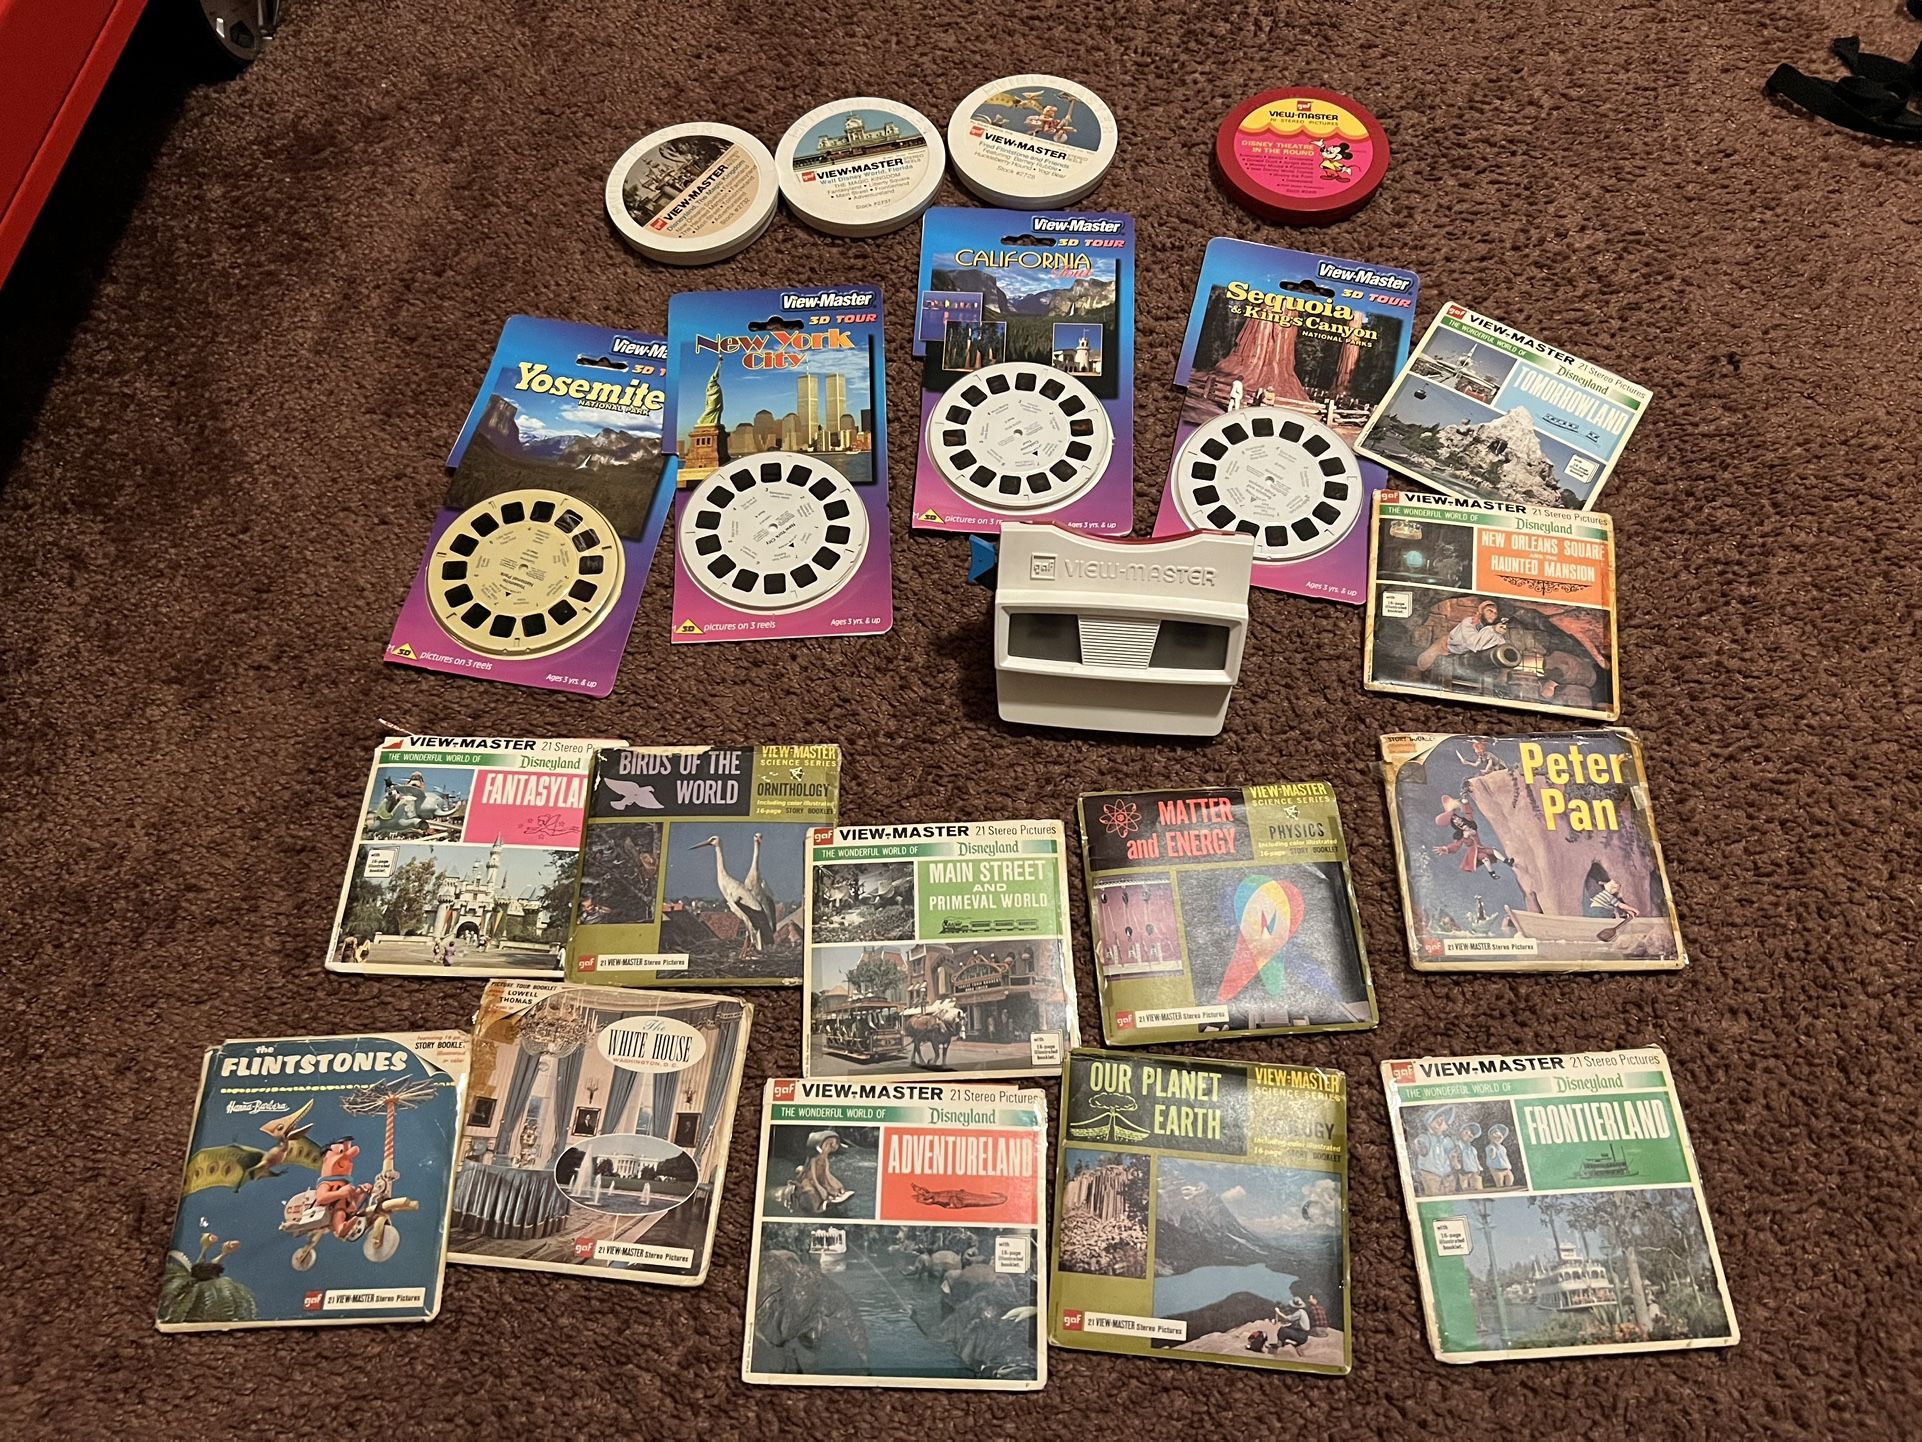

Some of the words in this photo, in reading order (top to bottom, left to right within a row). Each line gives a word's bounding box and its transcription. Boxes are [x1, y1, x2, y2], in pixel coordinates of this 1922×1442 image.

[1269, 110, 1339, 121] VIEW-MASTER
[1241, 140, 1274, 148] DISNEY
[1276, 142, 1314, 150] THEATRE
[1033, 218, 1121, 234] View-Master
[1058, 238, 1080, 247] 3D
[1084, 239, 1125, 248] TOUR
[955, 249, 1091, 270] CALIFORNIA
[1319, 263, 1411, 291] View-Master
[783, 293, 872, 309] View-Master
[1226, 281, 1354, 321] Sequoia
[1341, 289, 1364, 299] 3D
[1369, 294, 1412, 308] TOUR
[809, 316, 830, 325] 3D
[836, 314, 877, 324] TOUR
[1230, 305, 1242, 314] &
[1305, 315, 1378, 340] Canyon
[613, 338, 668, 359] View-Ma
[695, 333, 770, 355] New
[770, 328, 855, 351] York
[1302, 330, 1343, 343] NATIONAL
[1345, 338, 1373, 348] PARKS
[741, 351, 808, 369] City
[1448, 306, 1466, 319] gaf
[1470, 314, 1576, 366] VIEW-MASTER
[1588, 366, 1614, 384] Stereo
[1615, 379, 1647, 400] Pictures
[632, 364, 655, 374] 3D
[515, 362, 665, 411] Yosemite
[1556, 365, 1609, 396] Disneyland
[578, 400, 623, 412] NATIONAL
[625, 406, 650, 416] PARK
[1513, 366, 1629, 435] TOMORROWLAND
[1388, 506, 1402, 514] THE
[1403, 508, 1441, 518] WONDERFUL
[1444, 512, 1470, 521] WORLD
[1470, 514, 1479, 522] OF
[1404, 493, 1527, 514] VIEW-MASTER
[1532, 508, 1542, 516] 21
[1544, 509, 1573, 520] Stereo
[1574, 513, 1608, 526] Pictures
[1515, 517, 1573, 535] Disneyland
[1481, 530, 1506, 548] NEW
[1511, 533, 1559, 555] ORLEANS
[1563, 539, 1605, 561] SQUARE
[1033, 561, 1055, 576] gaf
[1064, 558, 1218, 587] VIEW-MASTER
[1490, 555, 1539, 575] HAUNTED
[1544, 562, 1595, 582] MANSION
[704, 623, 736, 632] pictures
[757, 620, 776, 629] reels
[420, 651, 453, 663] pictures
[454, 657, 466, 666] on
[473, 661, 493, 671] reels
[409, 736, 537, 751] VIEW-MASTER
[541, 741, 553, 751] 21
[554, 741, 584, 753] Stereo
[761, 745, 836, 760] VIEW-MASTER
[389, 752, 402, 762] THE
[403, 752, 443, 763] WONDERFUL
[445, 753, 468, 763] WORLD
[469, 754, 482, 763] OF
[520, 755, 581, 771] Disneyland
[619, 751, 673, 776] BIRDS
[679, 751, 702, 775] OF
[709, 751, 741, 775] THE
[760, 759, 801, 767] SCIENCE
[804, 759, 837, 767] SERIES
[1519, 742, 1627, 784] Peter
[481, 772, 588, 809] FANTASYLA
[676, 780, 739, 804] WORLD
[757, 783, 831, 798] ORNITHOLOGY
[1249, 783, 1328, 799] VIEW-MASTER
[1251, 798, 1294, 807] SCIENCE
[1297, 795, 1330, 804] SERIES
[1540, 788, 1619, 831] Pan
[1158, 797, 1234, 826] MATTER
[814, 829, 833, 843] gaf
[840, 825, 969, 841] VIEW-MASTER
[975, 827, 985, 836] 21
[988, 826, 1017, 836] Stereo
[1020, 825, 1056, 835] Pictures
[1268, 822, 1325, 840] PHYSICS
[822, 849, 836, 858] THE
[838, 847, 879, 858] WONDERFUL
[882, 846, 907, 855] WORLD
[909, 846, 918, 855] OF
[957, 840, 1019, 857] Disneyland
[1127, 834, 1158, 861] and
[1166, 828, 1237, 857] ENERGY
[929, 862, 973, 884] MAIN
[980, 860, 1046, 882] STREET
[973, 882, 1007, 892] AND
[929, 893, 996, 911] PRIMEVAL
[1001, 891, 1048, 909] WORLD
[499, 996, 533, 1005] THOMAS
[643, 1019, 666, 1032] The
[255, 1044, 274, 1054] the
[415, 1041, 435, 1050] STORY
[437, 1041, 466, 1049] BOOKLE
[608, 1029, 647, 1059] WHITE
[651, 1035, 693, 1063] HOUSE
[221, 1051, 408, 1077] FLINTSTONES
[1419, 1057, 1565, 1078] VIEW-MASTER
[1569, 1057, 1581, 1068] 21
[1585, 1055, 1617, 1068] Stereo
[1620, 1053, 1660, 1066] Pictures
[1090, 1061, 1132, 1094] OUR
[1142, 1066, 1222, 1102] PLANET
[1255, 1067, 1340, 1093] VIEW-MASTER
[1554, 1074, 1624, 1093] Disneyland
[773, 1083, 794, 1098] gaf
[801, 1084, 943, 1101] VIEW-MASTER
[950, 1089, 961, 1102] 21
[964, 1090, 996, 1103] Stereo
[999, 1091, 1039, 1104] Pictures
[1255, 1086, 1300, 1098] SCIENCE
[1304, 1091, 1341, 1102] SERIES
[1406, 1089, 1421, 1098] THE
[1423, 1086, 1470, 1098] WONDERFUL
[1472, 1084, 1501, 1095] WORLD
[1502, 1083, 1513, 1092] OF
[781, 1107, 796, 1117] THE
[798, 1107, 844, 1118] WONDERFUL
[846, 1108, 874, 1119] WORLD
[876, 1109, 886, 1119] OF
[928, 1107, 996, 1126] Disneyland
[1153, 1104, 1222, 1140] EARTH
[1524, 1100, 1671, 1145] FRONTIERLAND
[887, 1134, 1033, 1177] ADVENTURELAND
[576, 1242, 593, 1254] gaf
[598, 1246, 606, 1254] 21
[606, 1245, 644, 1258] VIEW-MASTER
[644, 1251, 663, 1260] Stereo
[665, 1253, 689, 1263] Pictures
